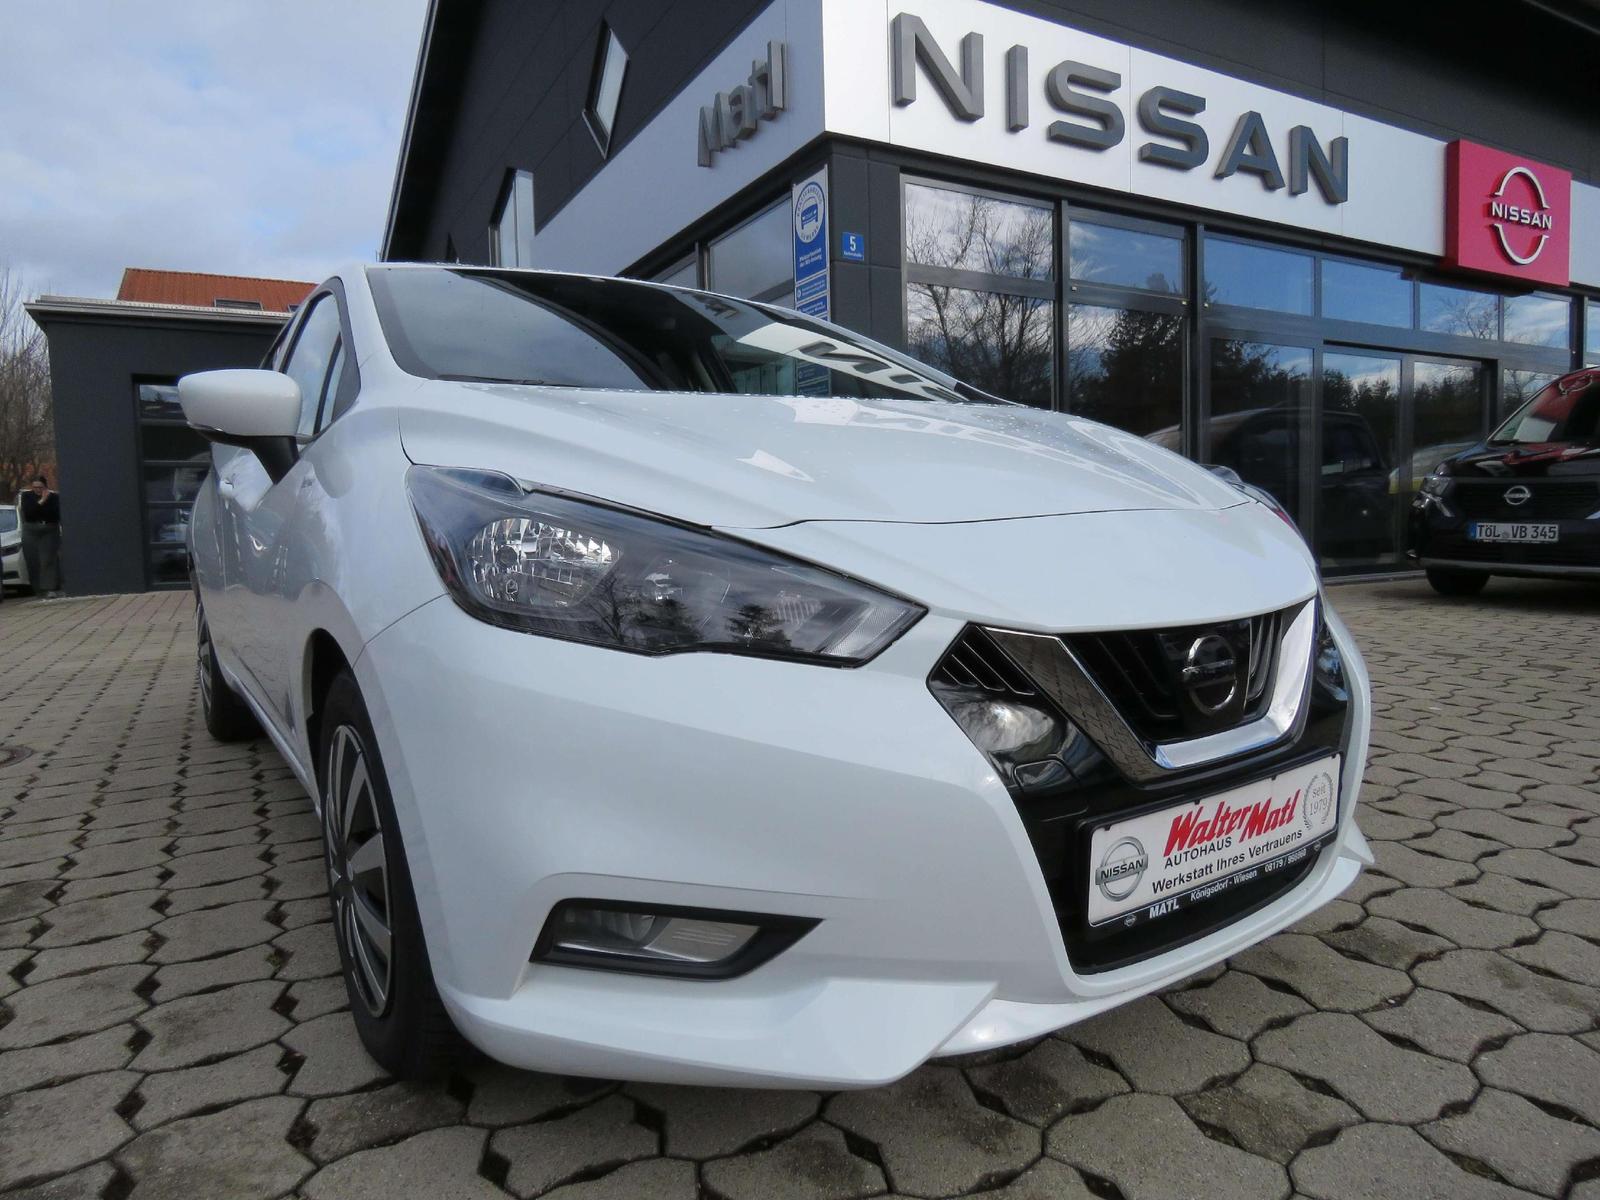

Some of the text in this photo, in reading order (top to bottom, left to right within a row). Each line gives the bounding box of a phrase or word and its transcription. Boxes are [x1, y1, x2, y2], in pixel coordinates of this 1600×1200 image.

[697, 40, 785, 167] Matl
[894, 11, 1348, 204] NISSAN
[1491, 201, 1552, 230] NISSAN
[849, 235, 856, 251] 5
[1477, 523, 1557, 539] TÖL VB 345
[1100, 857, 1145, 881] NISSAN
[1152, 863, 1213, 894] Werkstatt
[1216, 852, 1245, 872] Ihres
[1248, 829, 1303, 858] Vertrauens
[1164, 837, 1232, 869] AUTOHAUS
[1149, 898, 1179, 919] MATL
[1190, 879, 1229, 902] Königsdorf
